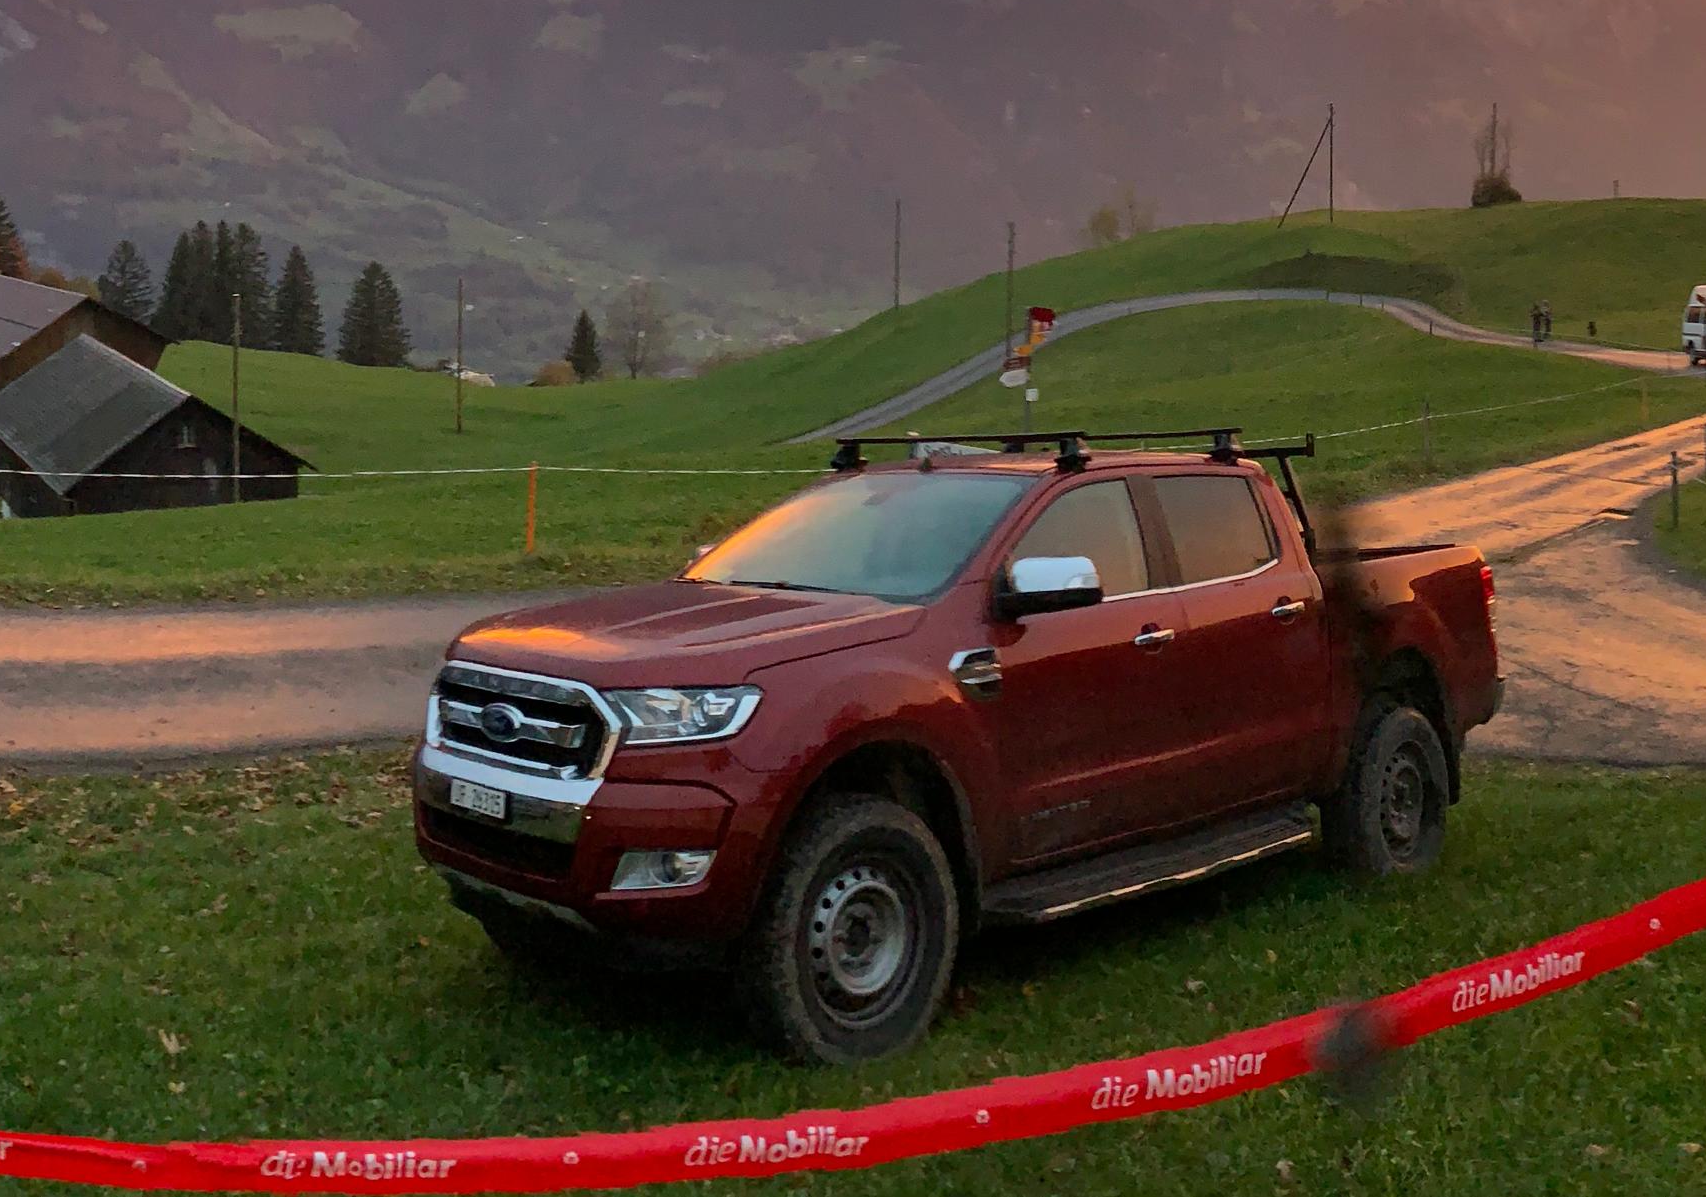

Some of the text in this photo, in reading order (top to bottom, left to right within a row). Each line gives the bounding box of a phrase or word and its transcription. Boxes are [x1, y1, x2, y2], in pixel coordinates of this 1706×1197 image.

[1451, 950, 1585, 1013] die Mobiliar
[1091, 1050, 1267, 1111] die Mobiliar
[310, 1150, 458, 1181] Mobiliar
[684, 1125, 870, 1167] die Mobiliar
